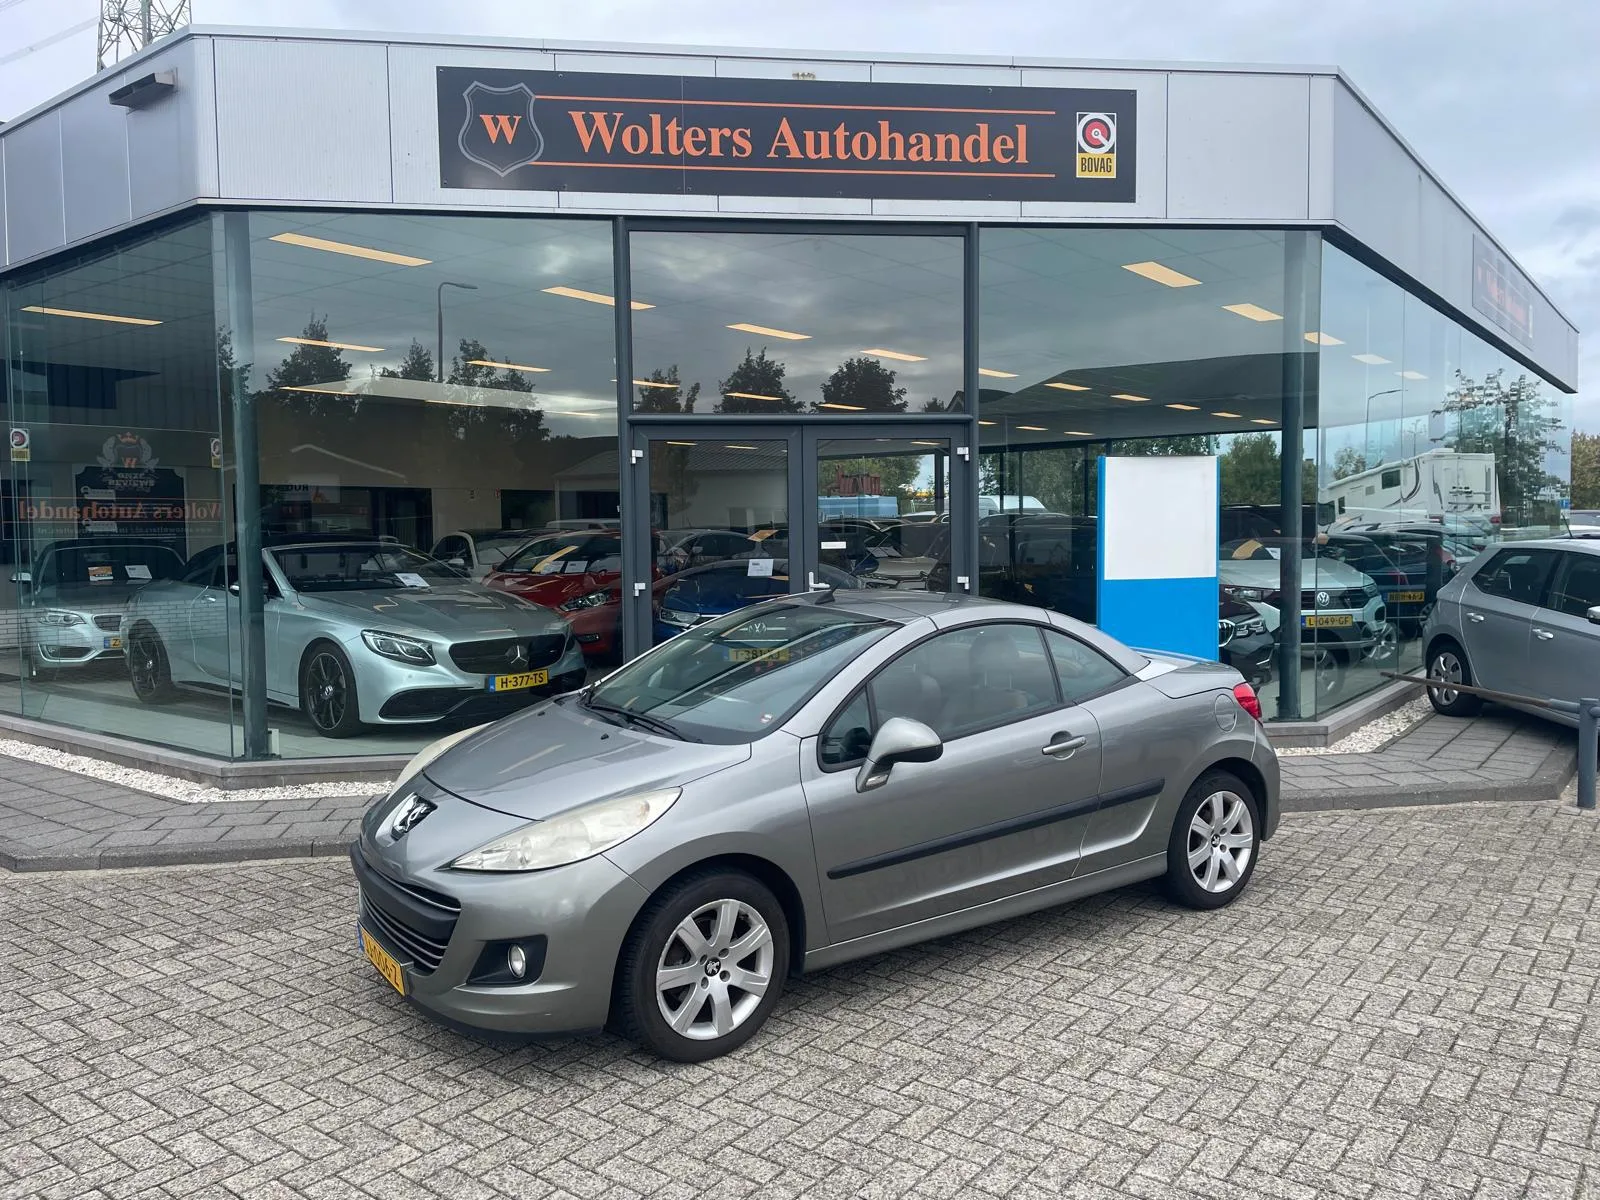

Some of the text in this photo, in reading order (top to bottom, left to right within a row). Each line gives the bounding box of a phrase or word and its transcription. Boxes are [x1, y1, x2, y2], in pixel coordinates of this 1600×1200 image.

[480, 114, 522, 145] W
[567, 110, 1029, 164] Wolters Autohandel
[1080, 156, 1113, 174] BOVAG
[1308, 616, 1350, 627] L-049-GF
[500, 672, 544, 688] H-377-TS
